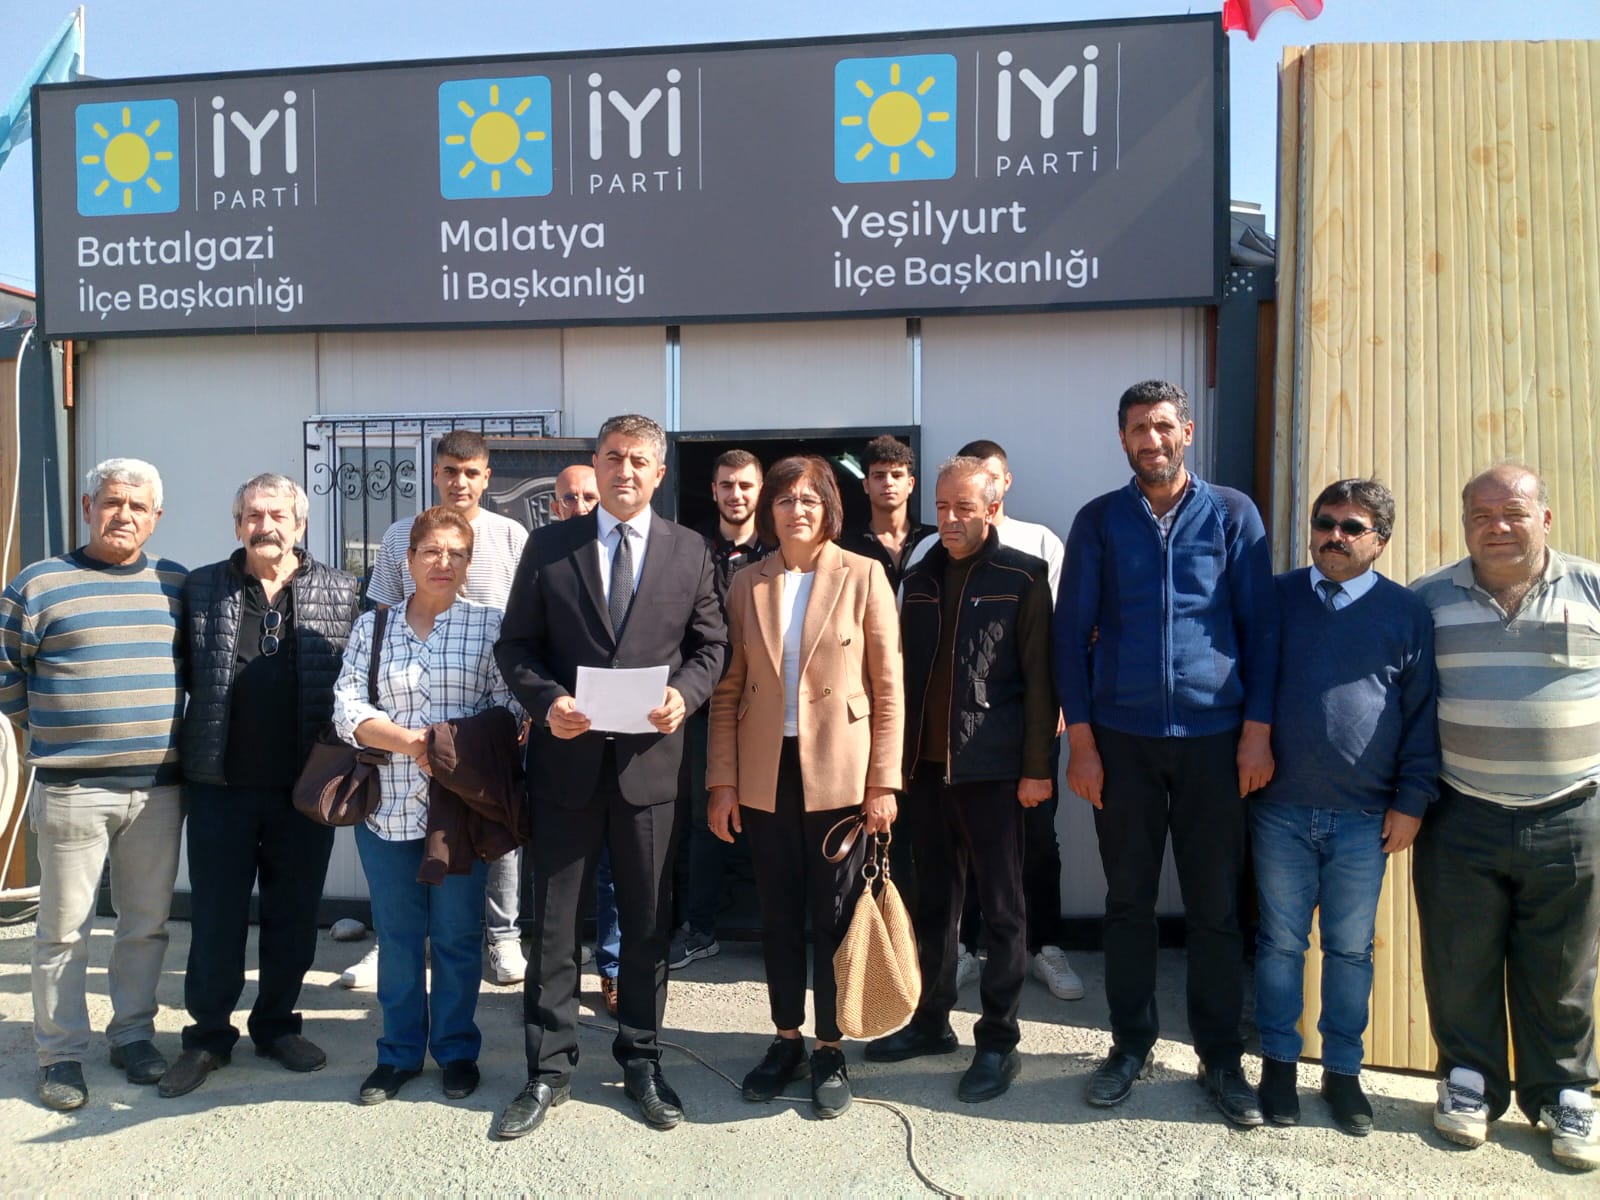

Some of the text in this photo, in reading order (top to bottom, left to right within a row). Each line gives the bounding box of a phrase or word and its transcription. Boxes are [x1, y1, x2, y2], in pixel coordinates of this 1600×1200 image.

[588, 68, 681, 160] İYİ
[996, 45, 1099, 141] İYİ
[211, 90, 297, 178] İYİ
[589, 166, 681, 194] PARTİ
[996, 146, 1097, 176] PARTİ
[213, 183, 298, 210] PARTİ
[440, 217, 604, 258] Malatya
[831, 200, 1026, 248] Yeşilyurt
[77, 226, 273, 271] Battalgazi
[441, 264, 644, 307] İl Başkanlığı
[834, 249, 1098, 296] İlçe Başkanlığı
[78, 276, 303, 320] İlçe Başkanlığı
